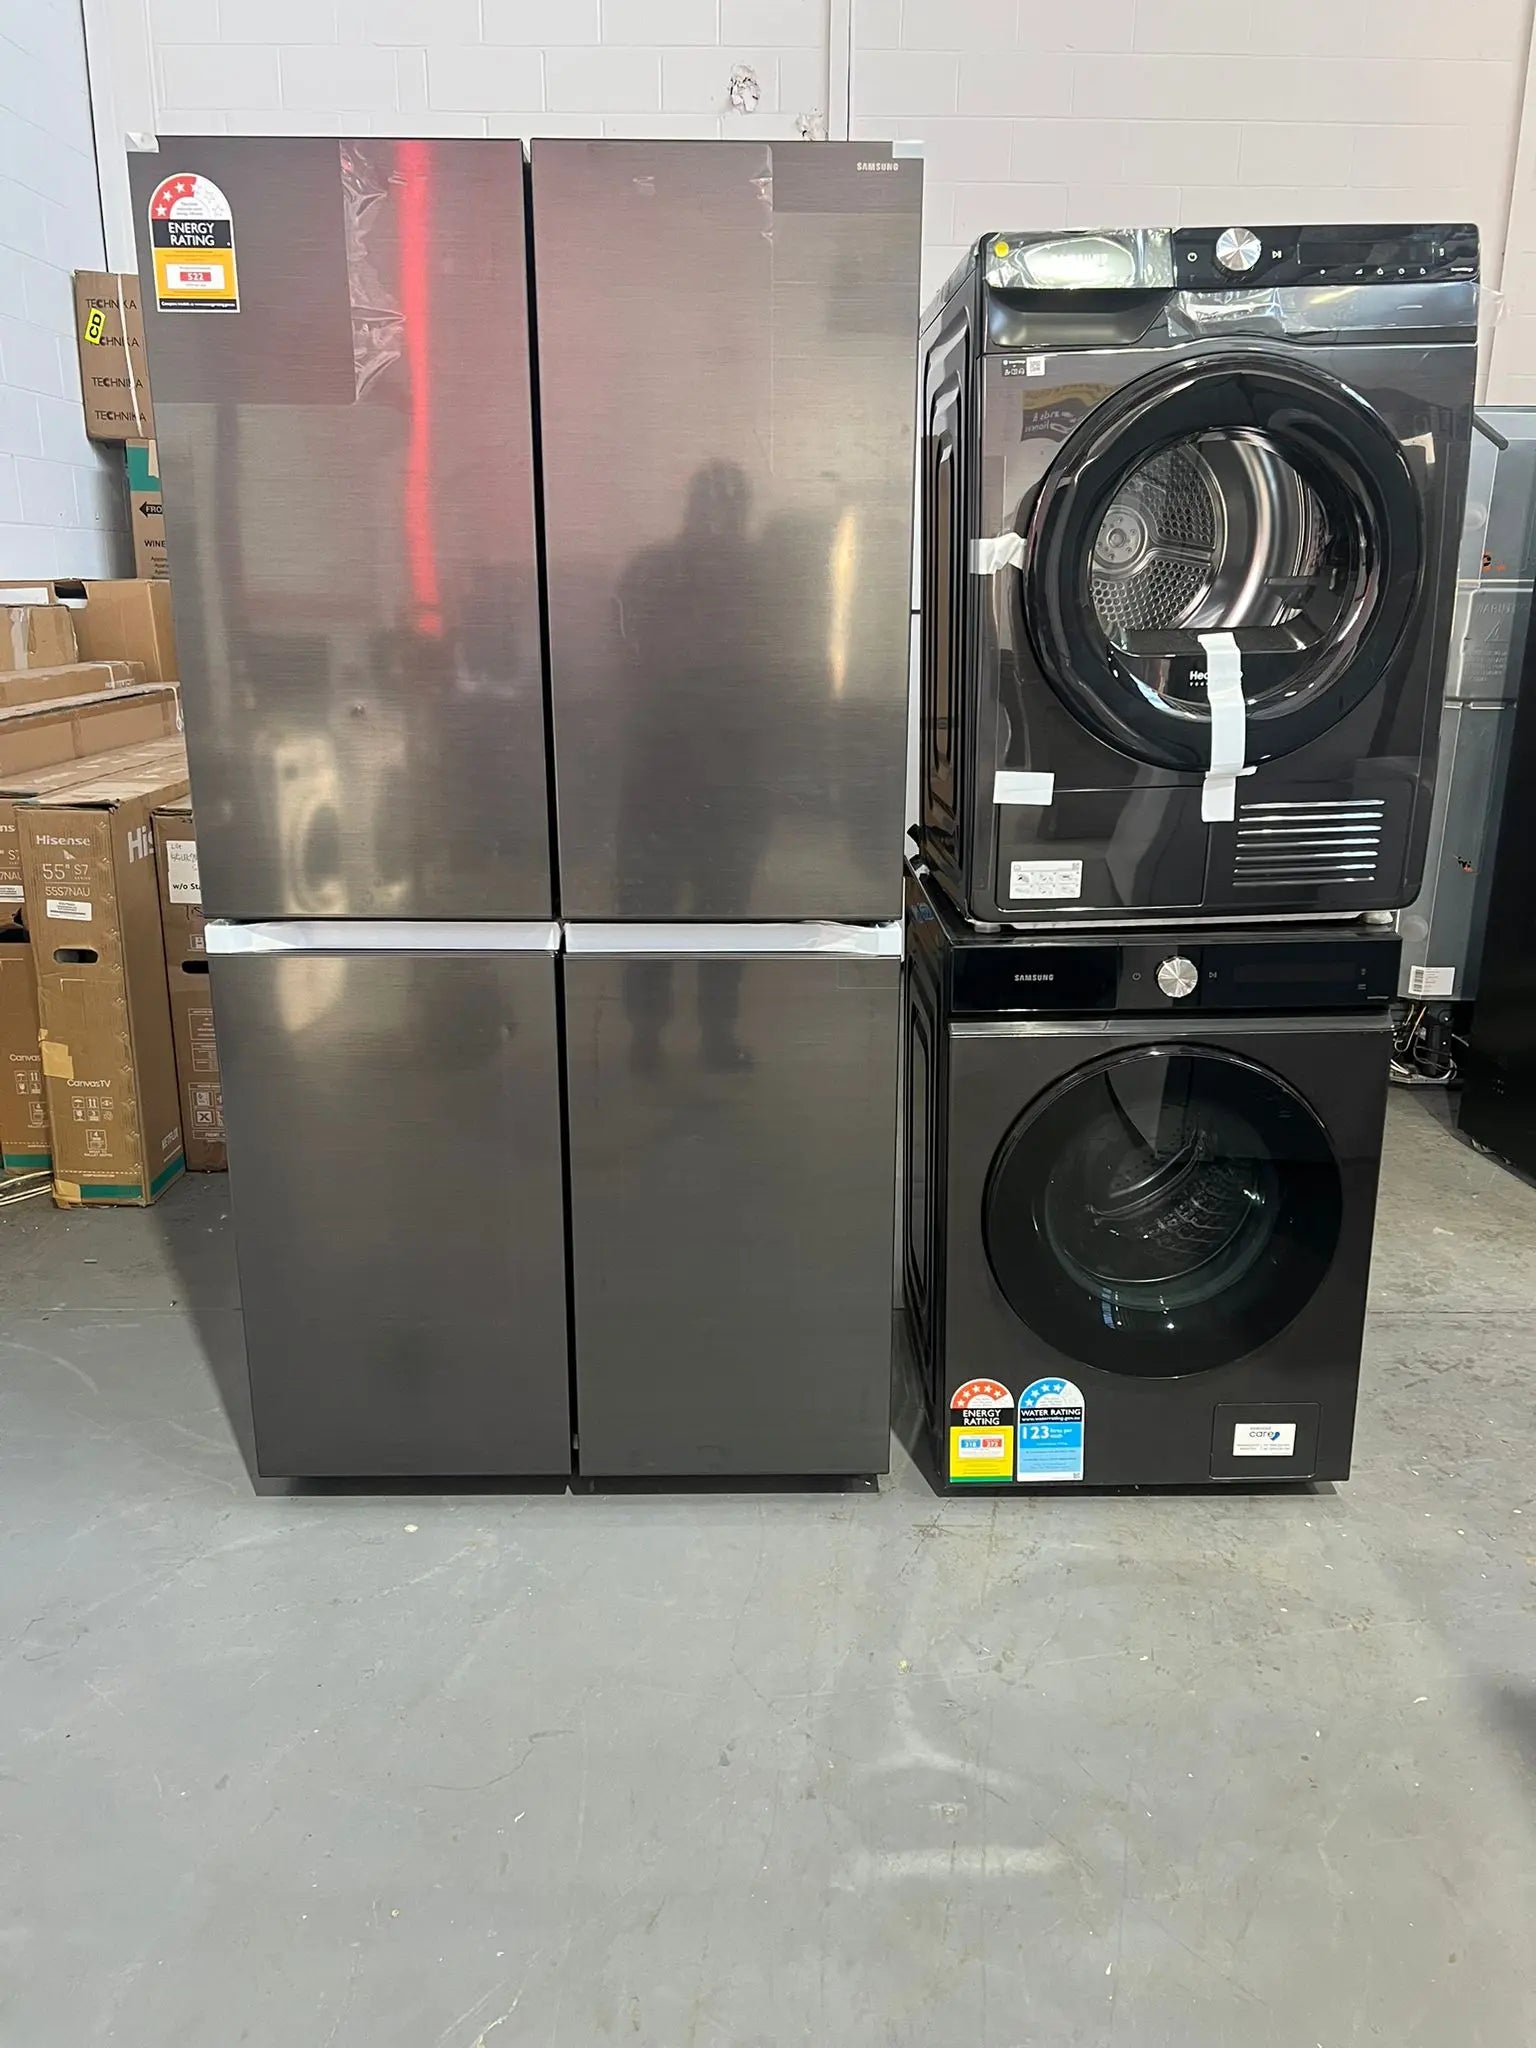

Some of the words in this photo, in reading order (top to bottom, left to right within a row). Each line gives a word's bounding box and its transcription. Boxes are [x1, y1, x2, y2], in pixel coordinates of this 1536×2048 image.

[856, 161, 899, 171] SAMSUNG
[168, 222, 215, 234] ENERGY
[170, 235, 215, 246] RATING
[187, 272, 204, 281] 522
[89, 313, 102, 339] CD
[144, 540, 166, 548] WINE
[36, 834, 91, 846] Hisense
[74, 864, 89, 876] S7
[45, 886, 90, 897] 55S7NAU
[1014, 973, 1055, 982] SAMSUNG
[66, 1079, 111, 1088] CanvasTV
[962, 1409, 1001, 1418] ENERGY
[1020, 1409, 1049, 1417] WATER
[1050, 1408, 1081, 1416] RATING
[963, 1417, 1000, 1426] RATING
[1022, 1425, 1049, 1440] 123
